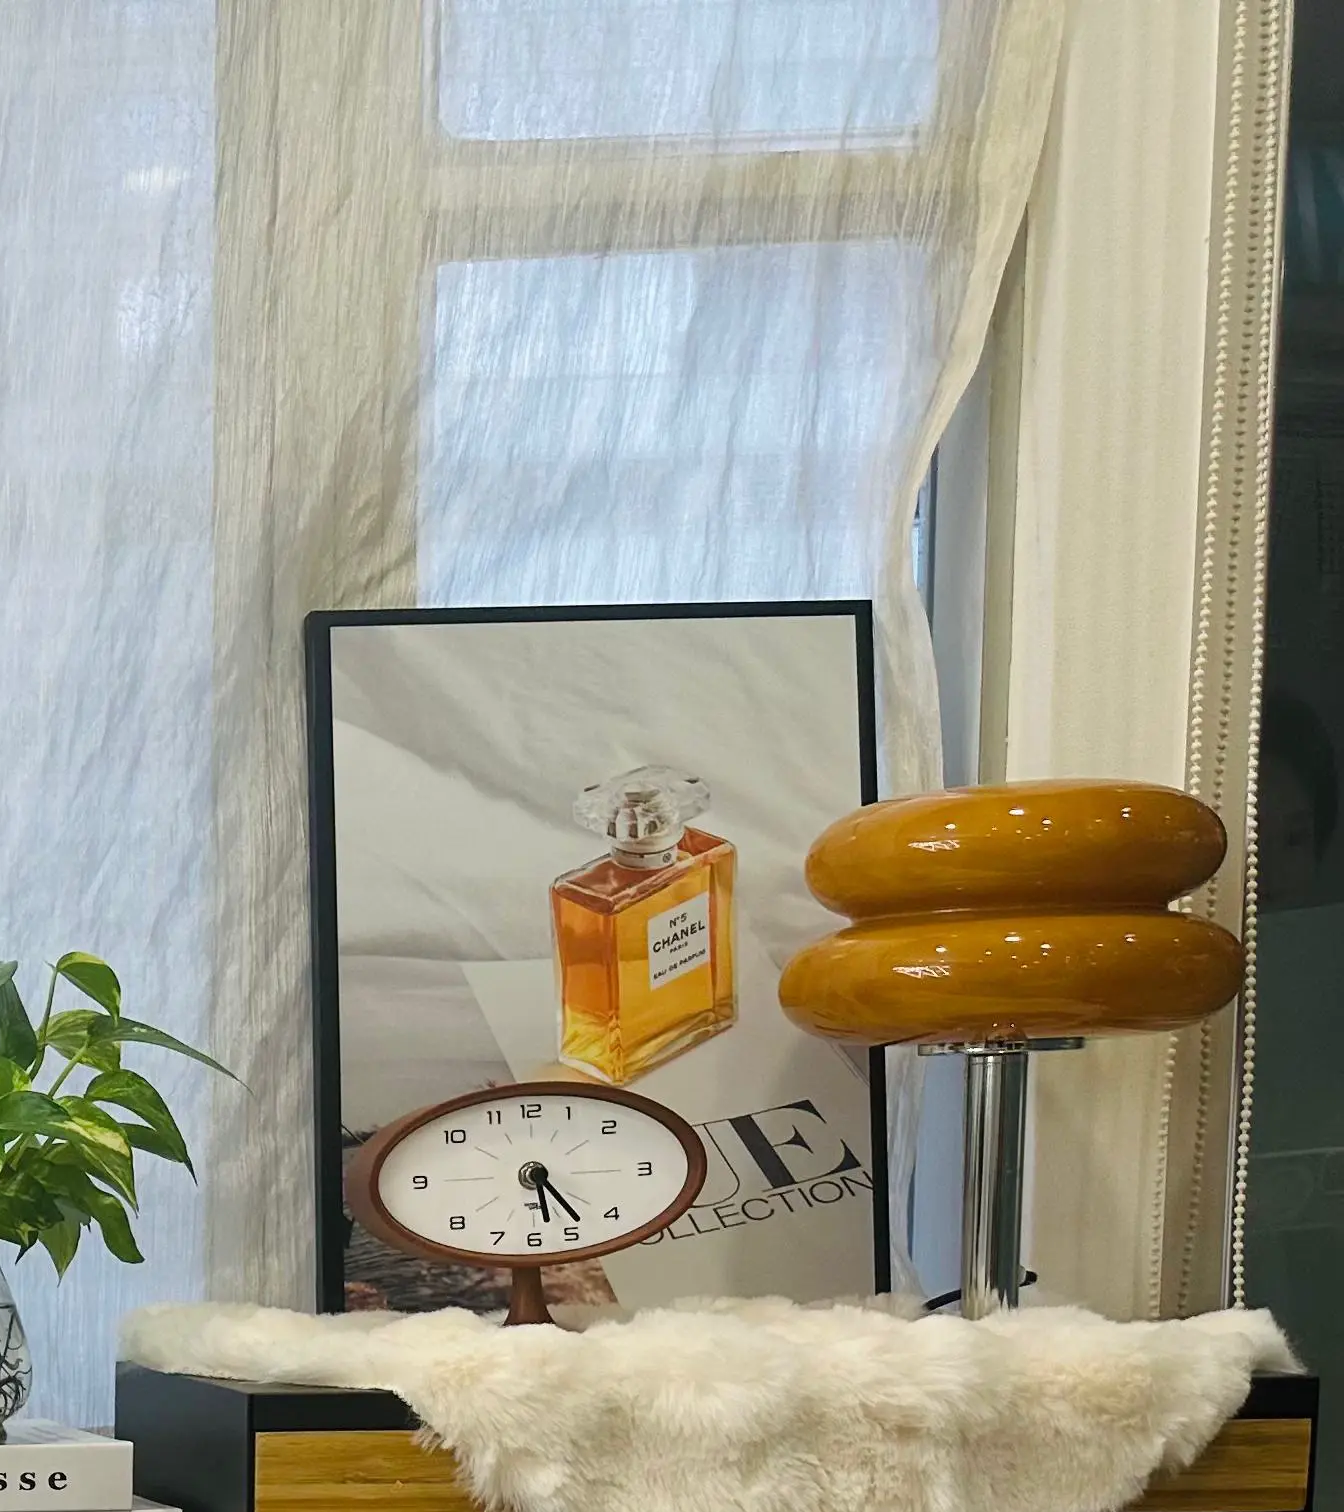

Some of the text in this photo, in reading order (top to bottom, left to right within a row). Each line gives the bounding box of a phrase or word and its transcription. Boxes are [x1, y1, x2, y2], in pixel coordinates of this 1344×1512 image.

[653, 919, 706, 953] CHANEL
[486, 1110, 503, 1125] 11
[519, 1103, 542, 1119] 12
[565, 1106, 572, 1121] 1
[601, 1120, 618, 1136] 2
[443, 1129, 466, 1145] 10
[637, 1161, 653, 1177] 3
[412, 1175, 428, 1190] 9
[603, 1206, 620, 1221] 4
[450, 1215, 466, 1231] 8
[490, 1231, 506, 1246] 7
[527, 1232, 542, 1247] 6
[563, 1227, 580, 1243] 5
